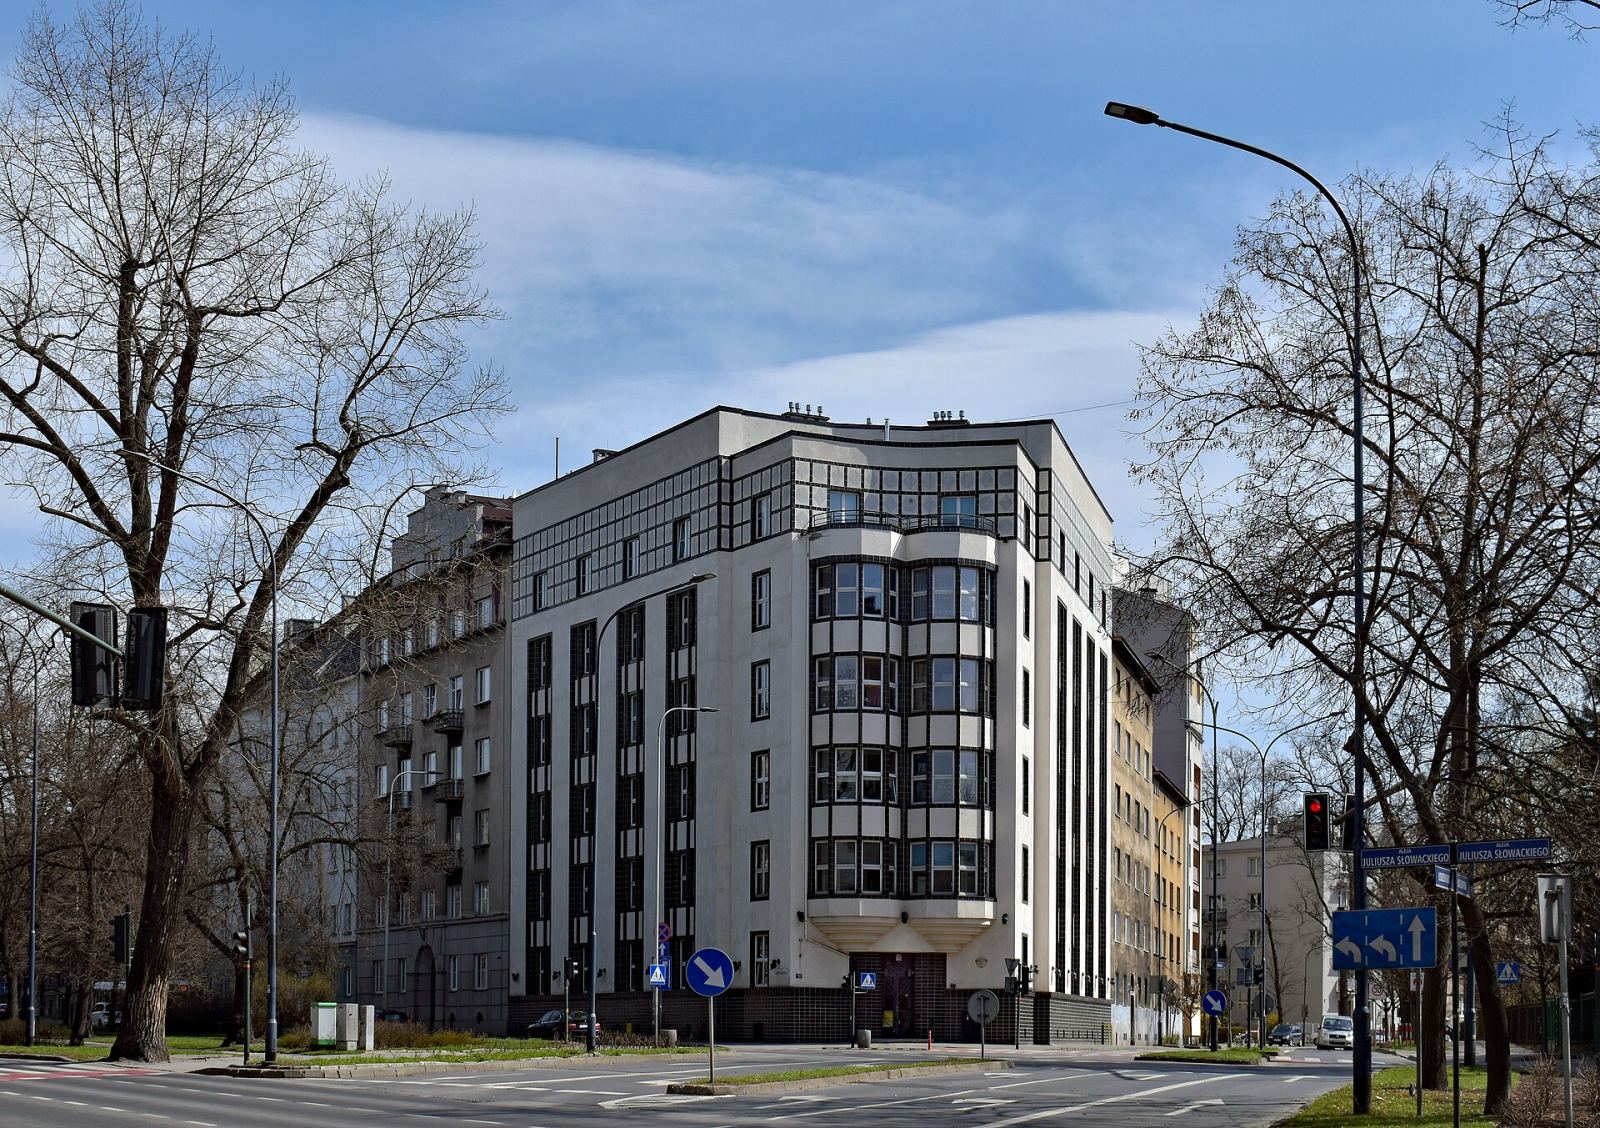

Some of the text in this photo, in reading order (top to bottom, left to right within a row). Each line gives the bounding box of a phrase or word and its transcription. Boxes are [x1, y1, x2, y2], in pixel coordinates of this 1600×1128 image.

[1363, 853, 1449, 867] JULIUSZA SŁOWACKIEGO
[1459, 847, 1548, 861] JULIUSZA SŁOWACKIEGO
